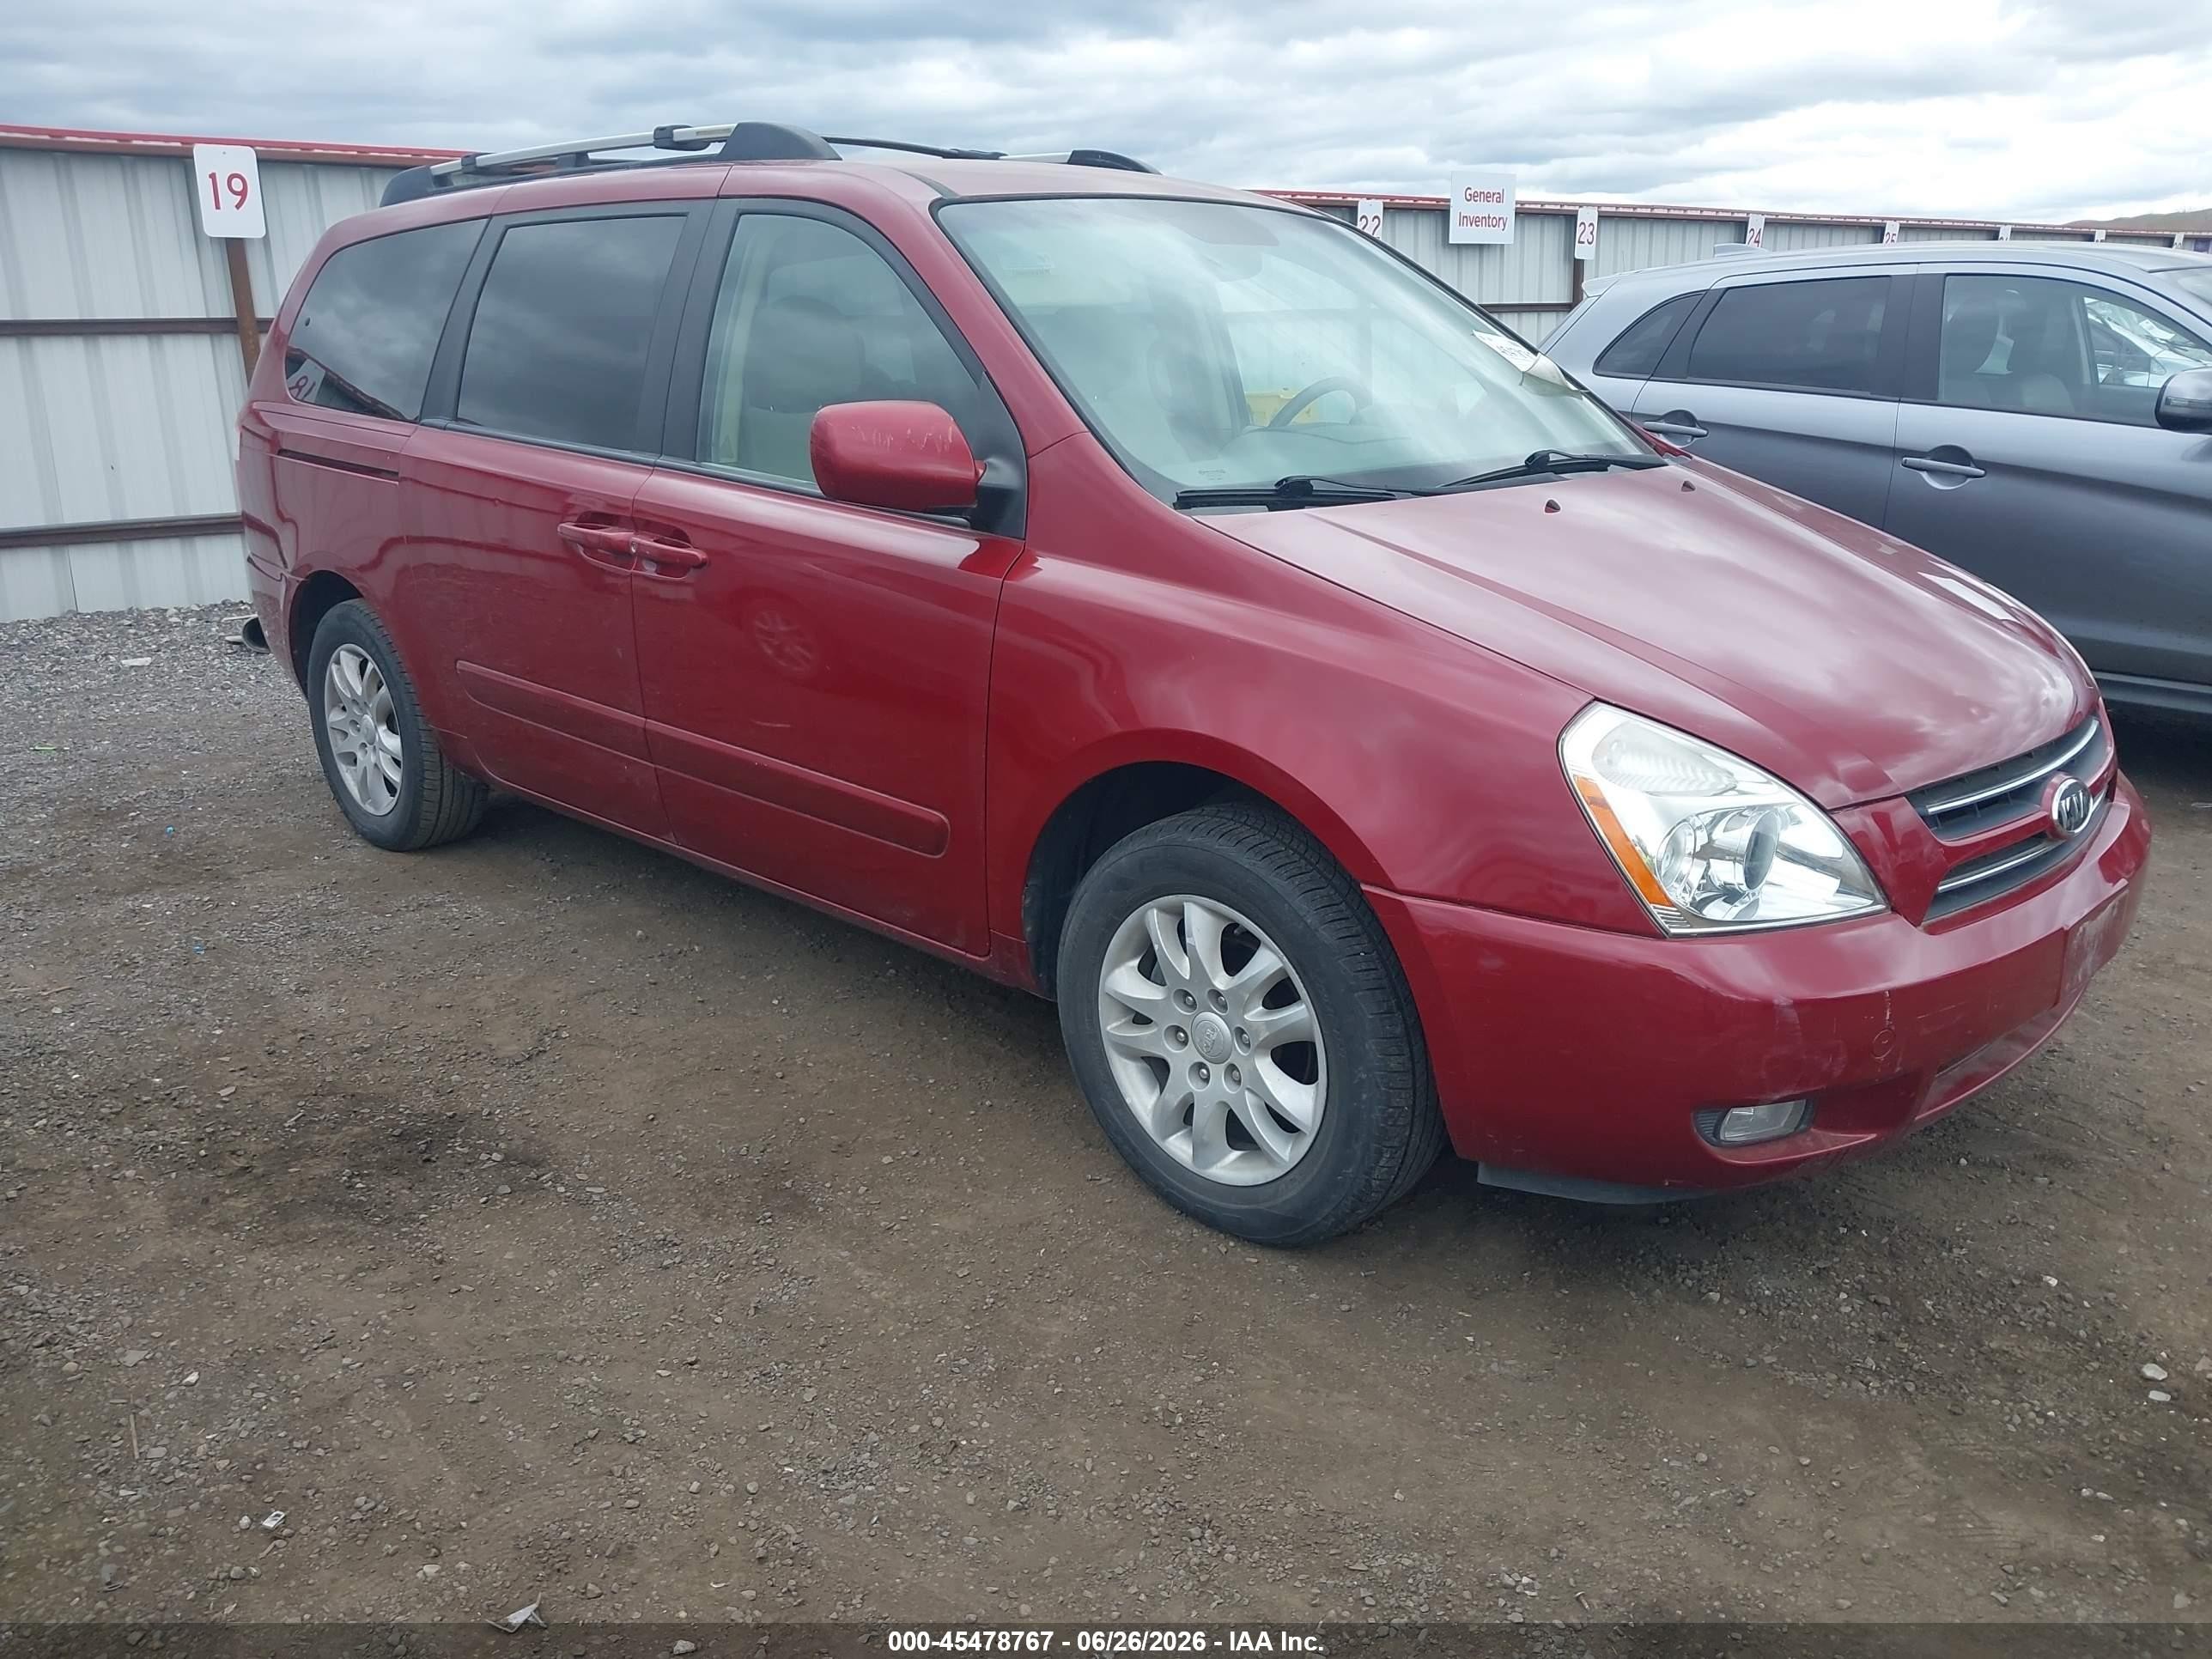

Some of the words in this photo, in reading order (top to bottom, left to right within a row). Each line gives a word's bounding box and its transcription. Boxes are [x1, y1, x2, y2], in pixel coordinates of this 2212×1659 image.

[209, 172, 248, 210] 19
[1464, 186, 1504, 204] General
[1359, 215, 1381, 239] 22
[1458, 211, 1508, 232] Inventory
[1577, 222, 1595, 245] 23
[1747, 228, 1761, 248] 24
